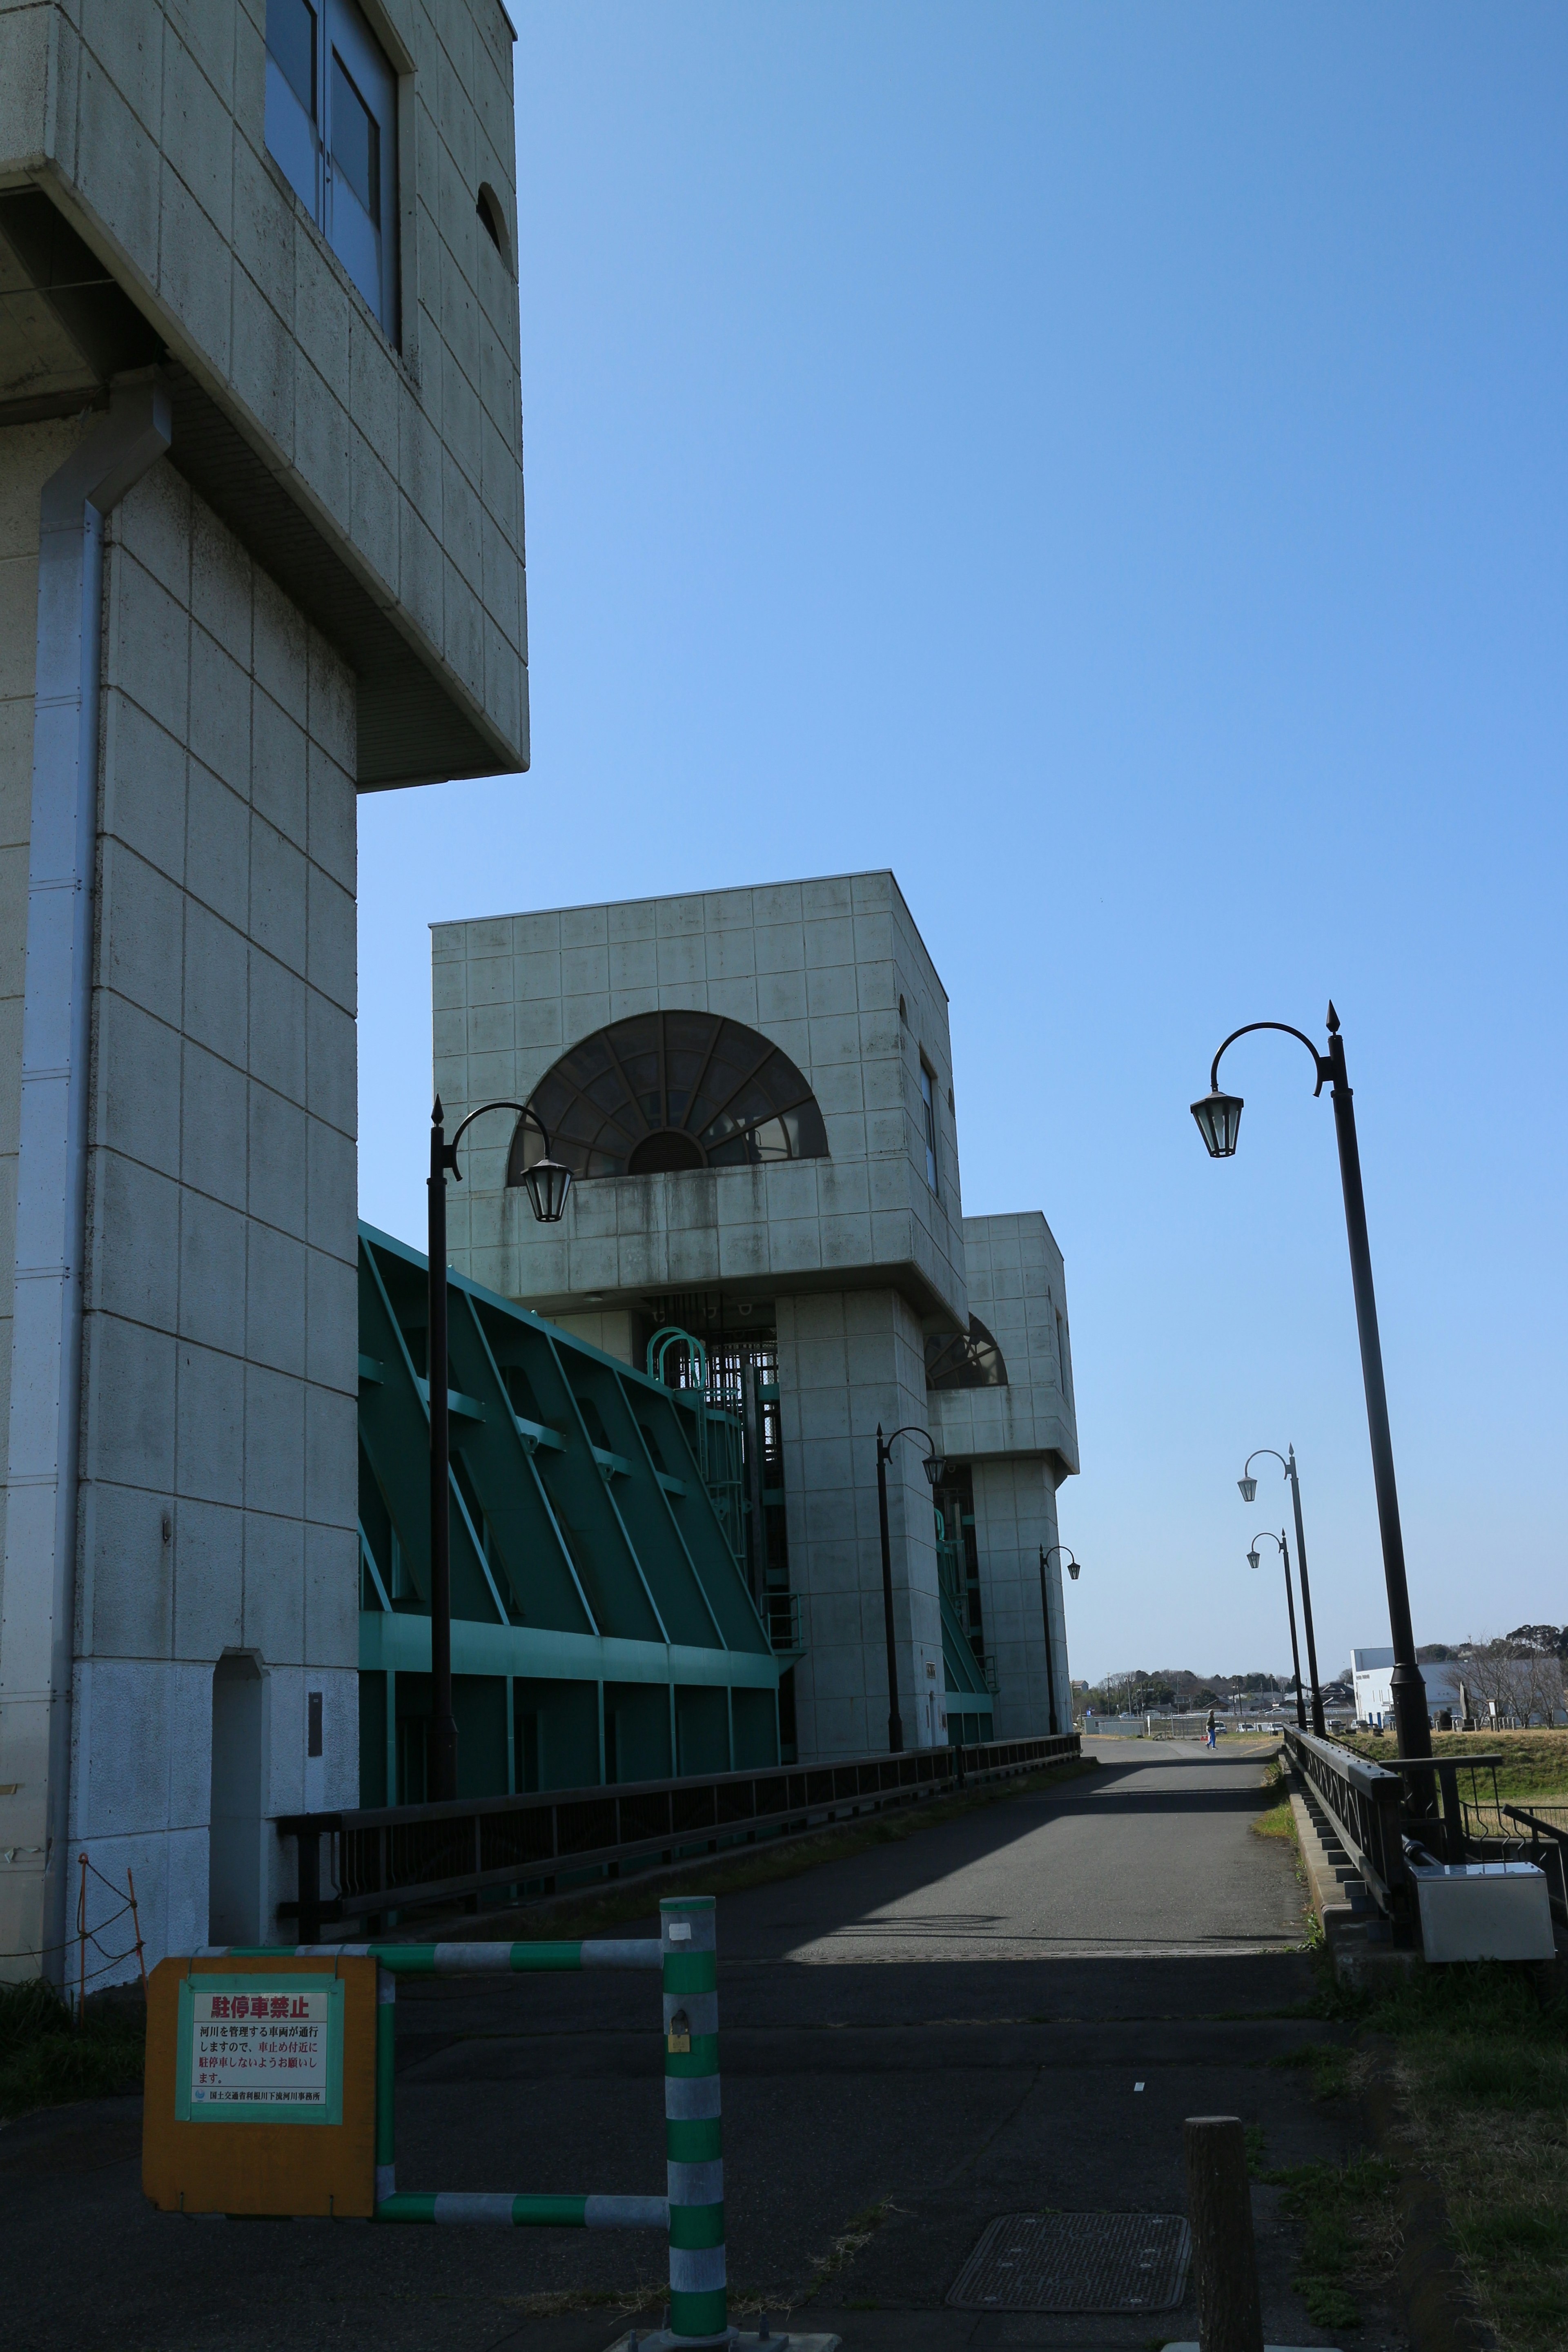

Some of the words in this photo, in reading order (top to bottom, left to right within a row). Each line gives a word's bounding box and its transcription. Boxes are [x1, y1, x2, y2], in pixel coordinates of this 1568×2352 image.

[211, 1996, 309, 2019] 駐停車禁止
[200, 2026, 318, 2038] 河川を管理する車両が通行
[200, 2042, 318, 2053] しますので、車止め付近に
[198, 2057, 317, 2068] 駐停車しないようお願いし
[199, 2073, 222, 2084] ます。
[209, 2091, 320, 2100] 国土交通省利根川下流河川事務所
